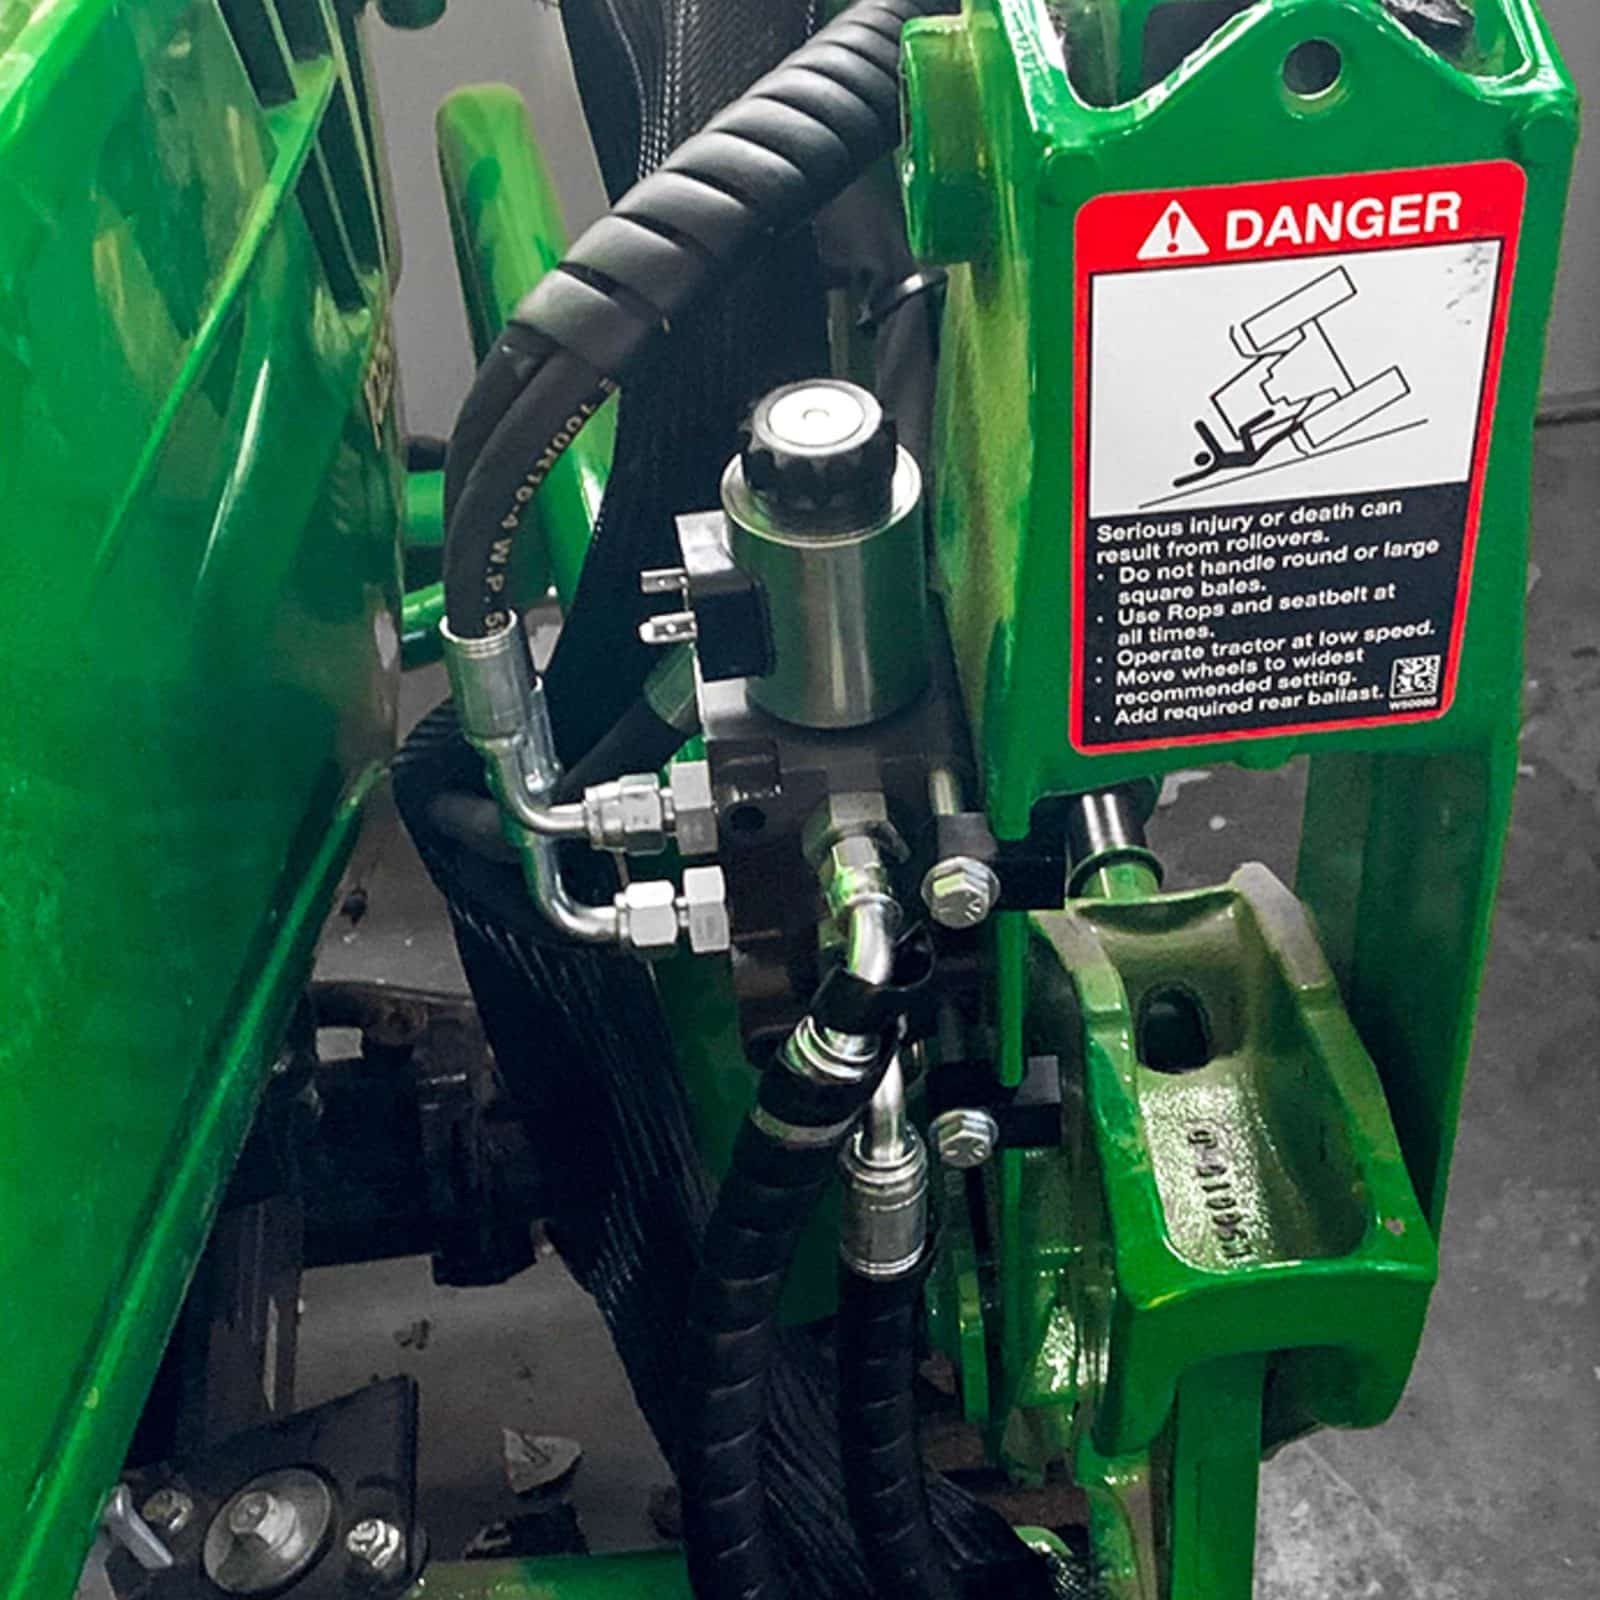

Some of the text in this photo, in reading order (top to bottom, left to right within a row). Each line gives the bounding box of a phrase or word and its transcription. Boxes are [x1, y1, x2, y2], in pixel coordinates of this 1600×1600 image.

[1225, 191, 1463, 251] DANGER
[1097, 500, 1402, 543] Serious injury or death can
[1097, 530, 1330, 564] result from rollovers.
[1119, 539, 1440, 583] Do not handle round or large
[1118, 578, 1266, 606] square bales.
[1118, 583, 1396, 625] Use Rops and seatbelt at
[1117, 625, 1215, 646] all times.
[1117, 619, 1436, 668] Operate tractor at low speed.
[1116, 648, 1365, 686] Move wheels to widest
[1114, 685, 1384, 726] Add required rear ballast.
[1115, 670, 1358, 706] recommended setting.
